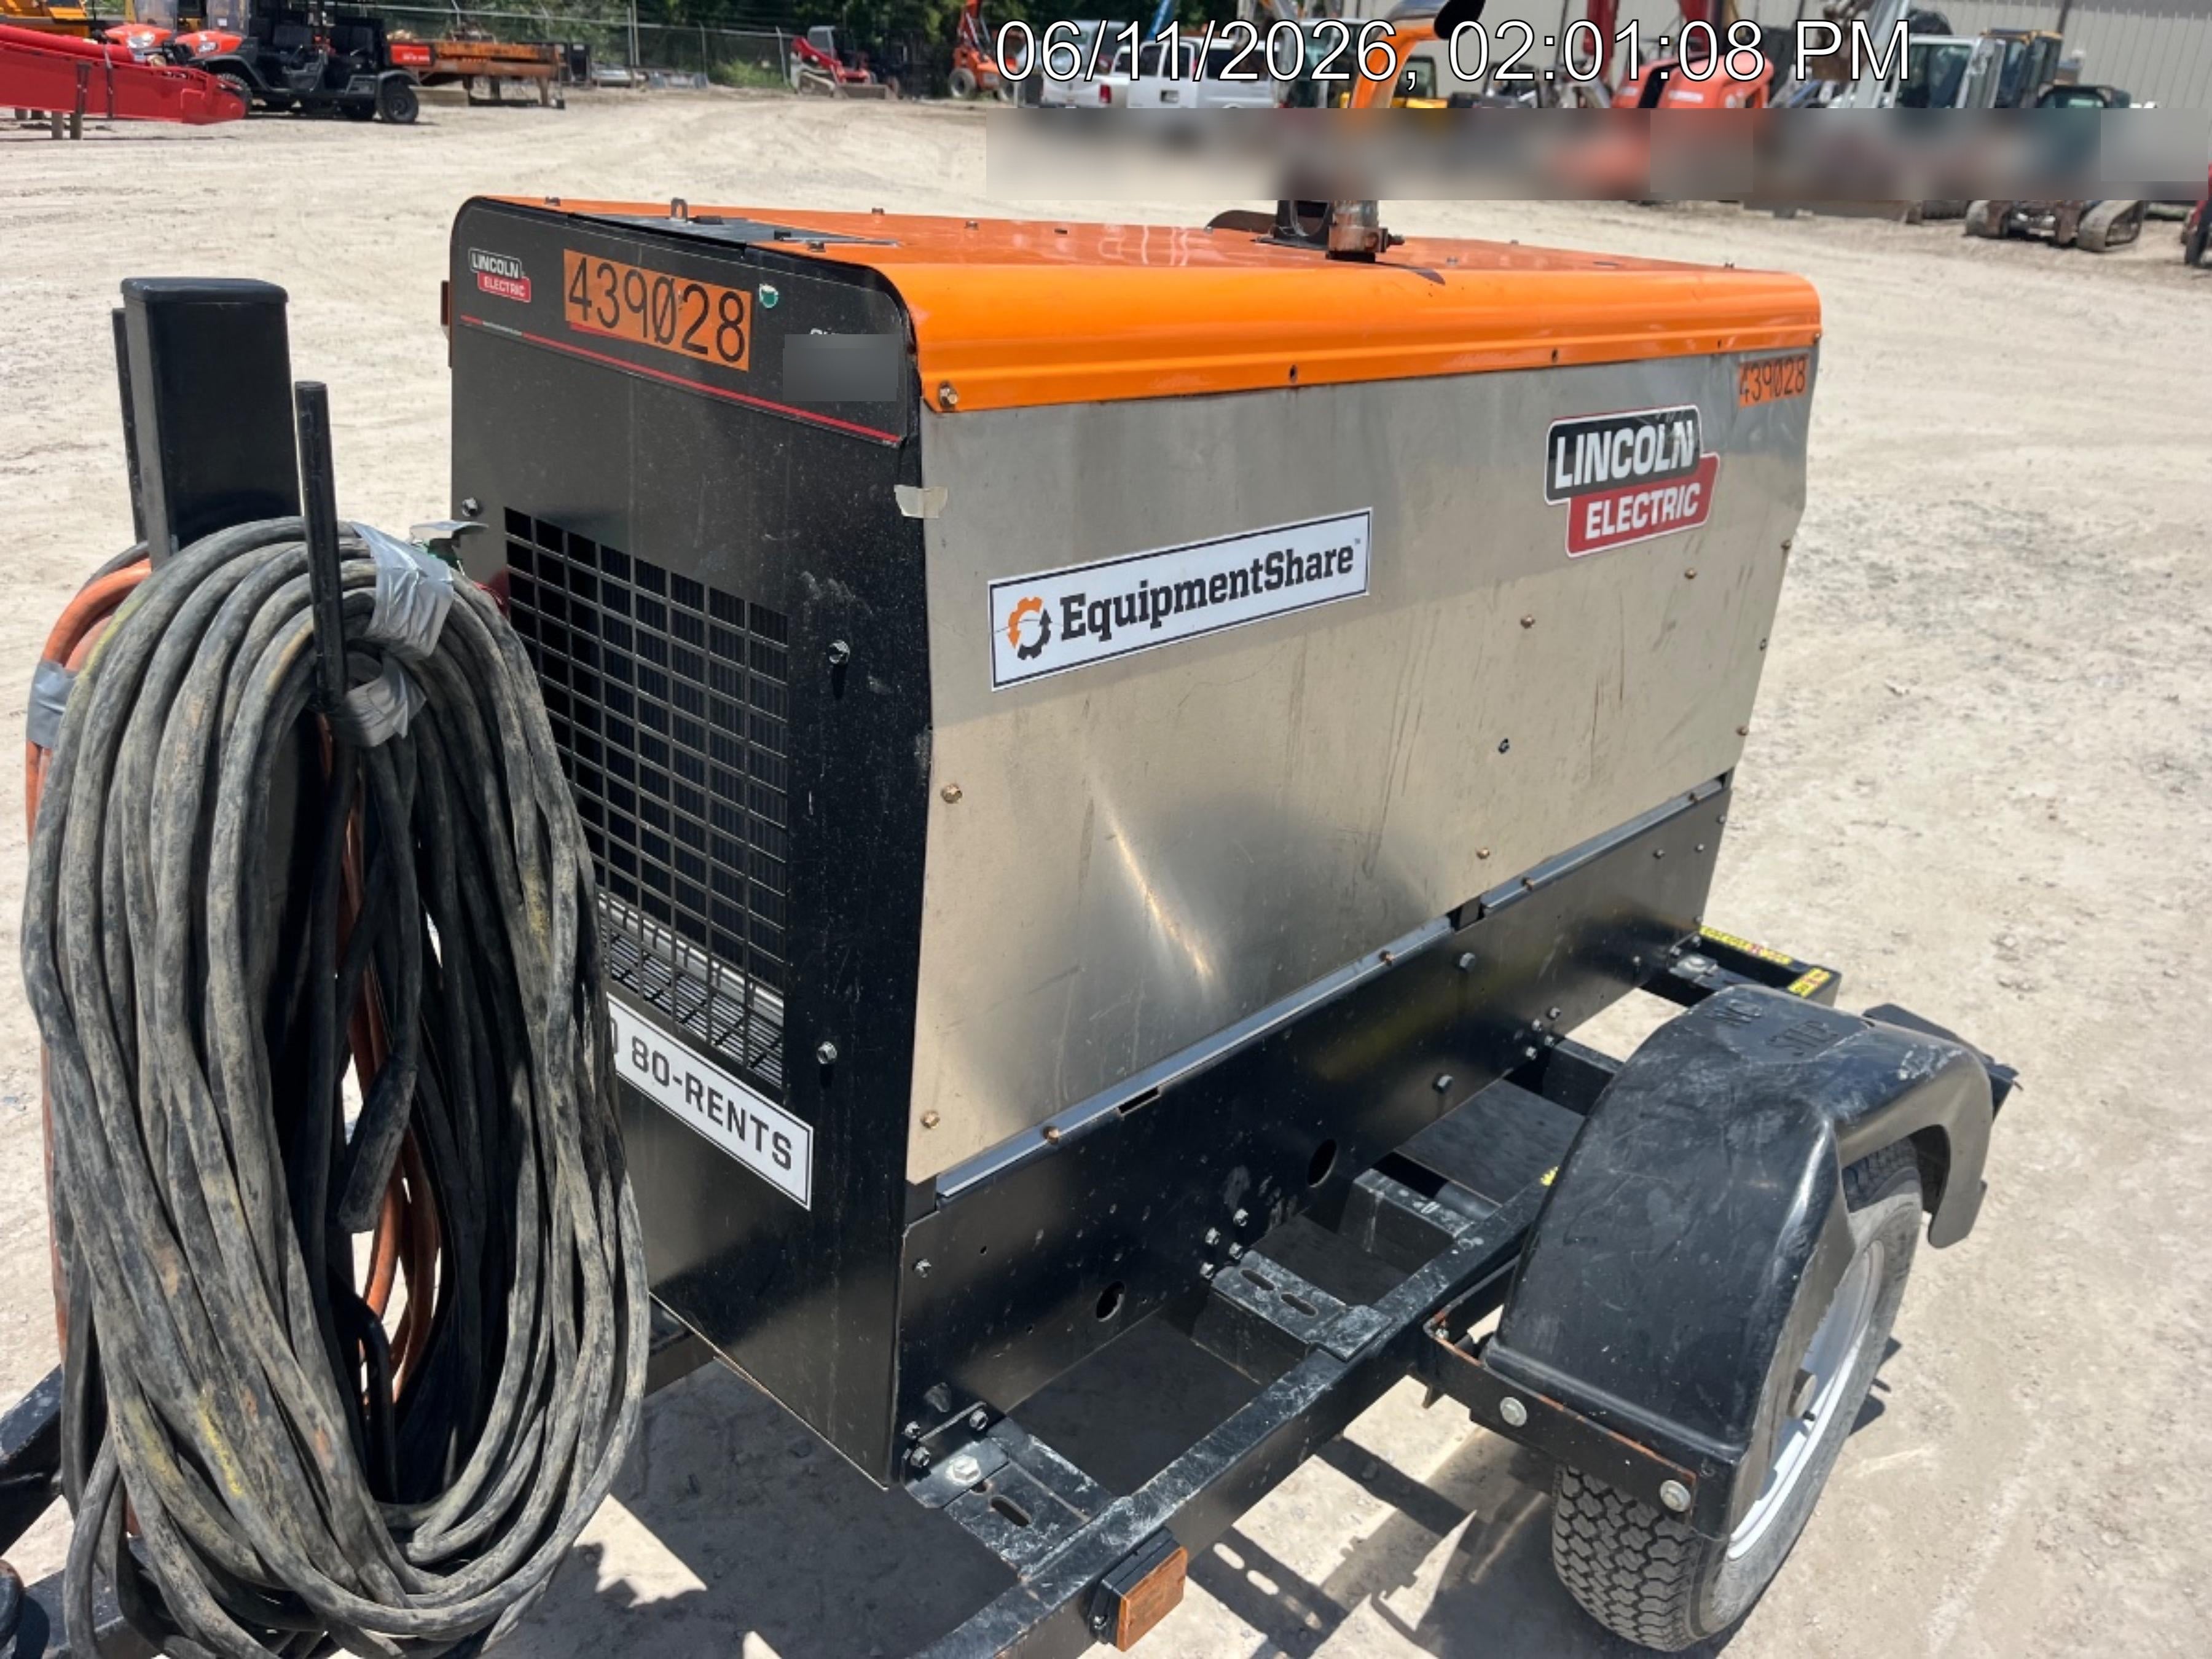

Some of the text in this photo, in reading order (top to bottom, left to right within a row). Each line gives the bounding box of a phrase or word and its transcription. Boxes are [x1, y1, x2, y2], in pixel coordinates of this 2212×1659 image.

[471, 251, 519, 278] LINCOLN
[484, 276, 527, 297] ELECTRIC
[568, 257, 745, 363] 439028
[1555, 420, 1695, 489] LINCOLN
[1585, 482, 1701, 539] ELECTRIC
[1060, 545, 1354, 642] EquipmentShare
[631, 1036, 793, 1171] 80-RENTS
